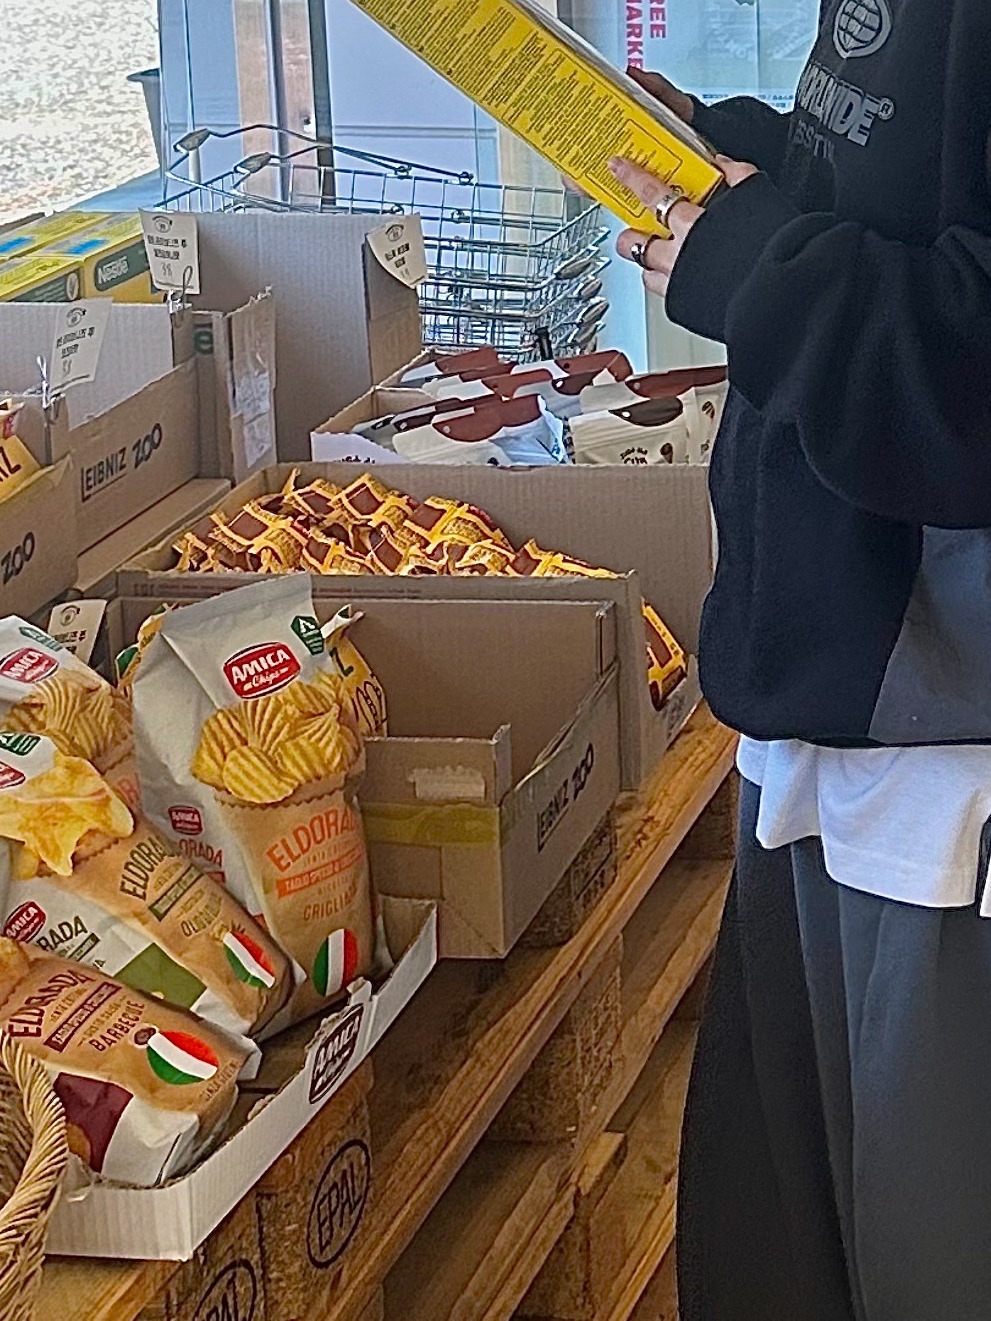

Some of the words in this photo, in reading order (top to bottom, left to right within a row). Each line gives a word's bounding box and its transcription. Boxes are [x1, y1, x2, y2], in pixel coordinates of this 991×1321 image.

[132, 422, 163, 470] ZOO
[1, 531, 35, 585] ZOO
[231, 648, 291, 684] AMICA
[89, 999, 145, 1052] BARBECUE
[317, 1161, 362, 1254] EPAL
